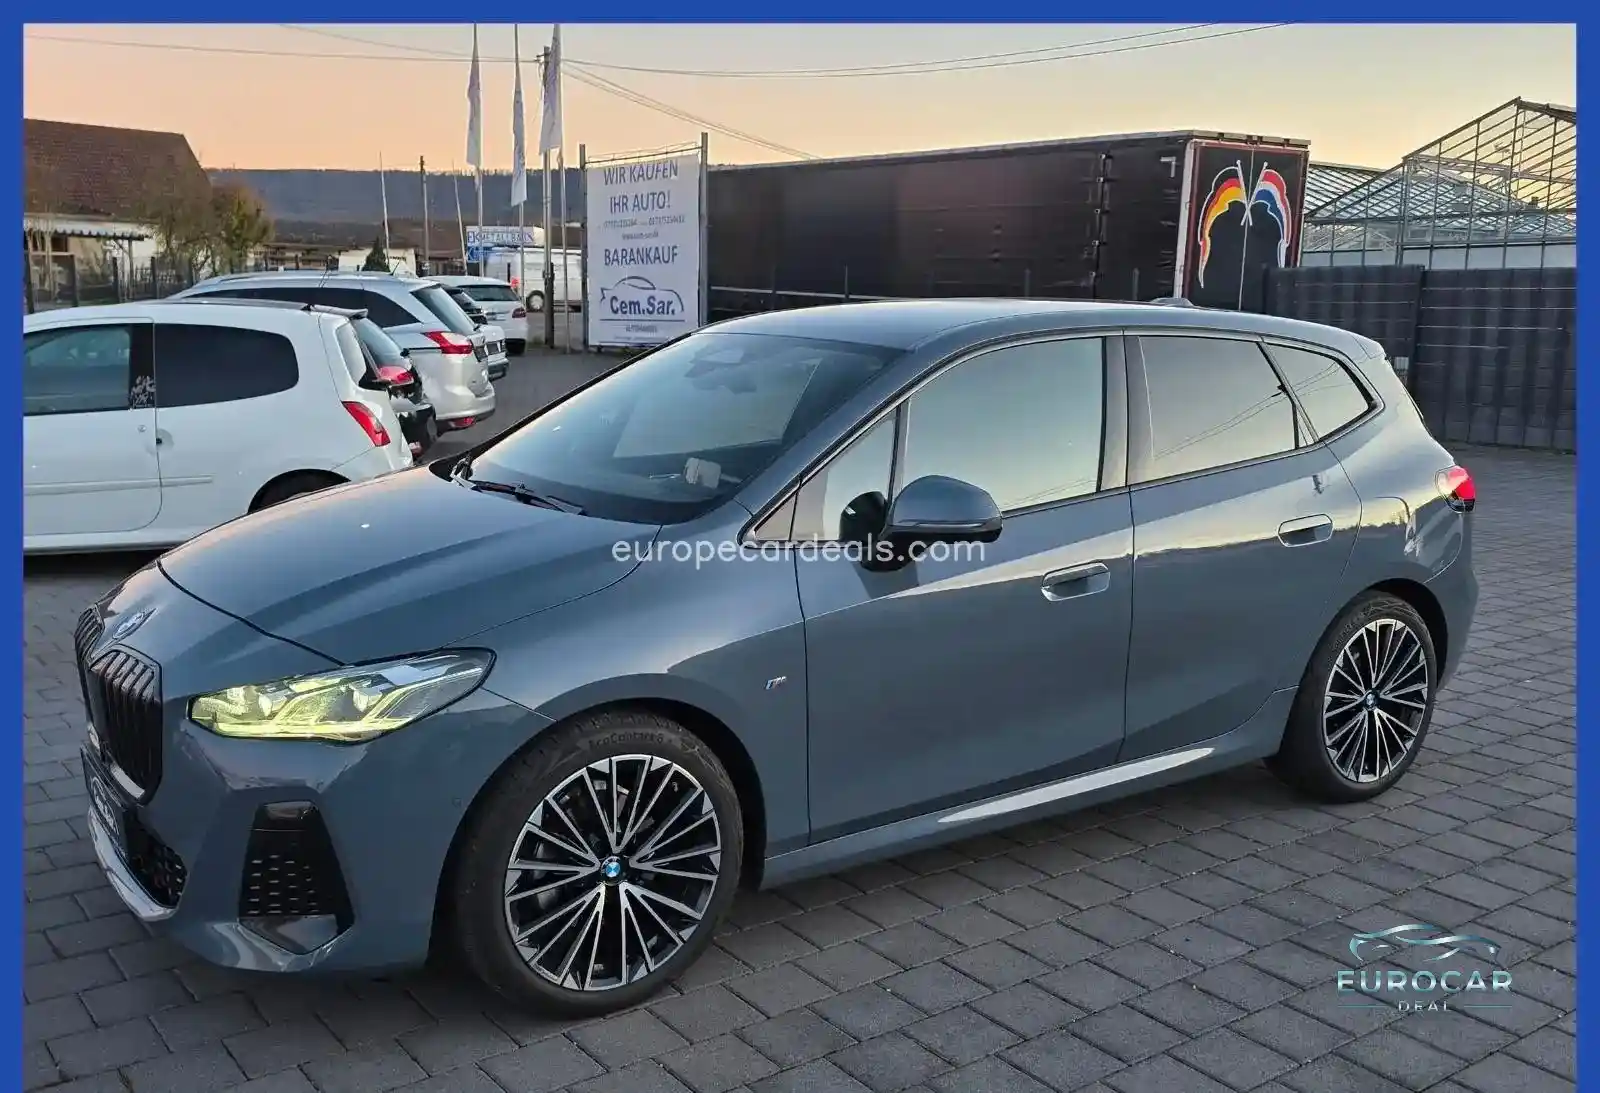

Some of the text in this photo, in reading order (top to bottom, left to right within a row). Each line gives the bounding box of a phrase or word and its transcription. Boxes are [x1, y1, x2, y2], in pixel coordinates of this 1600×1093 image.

[603, 160, 679, 186] WIR KAUFEN
[610, 190, 671, 214] IHR AUTO!
[604, 246, 678, 266] BARANKAUF
[610, 295, 676, 316] Cem.Sar.
